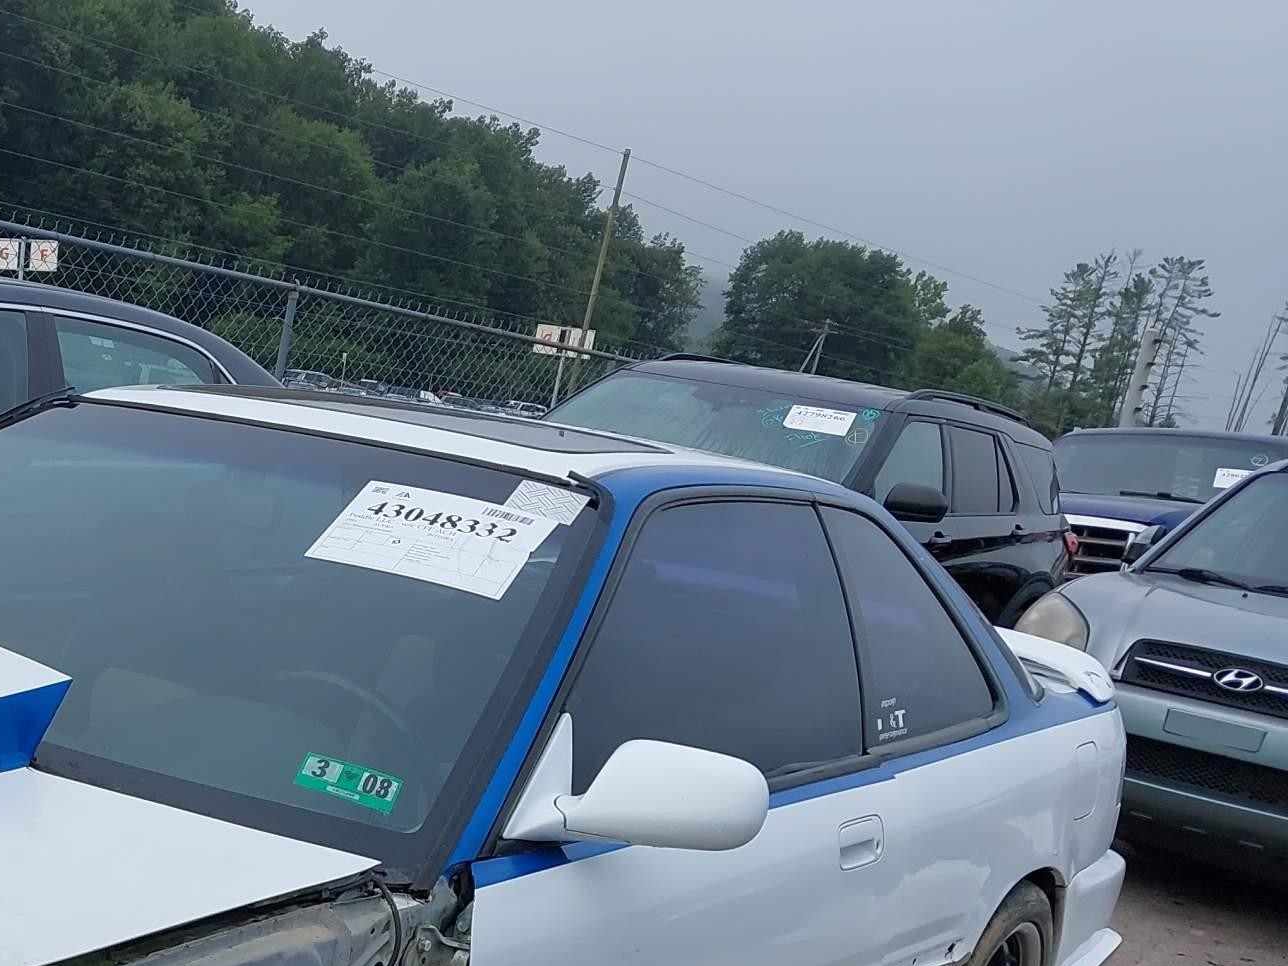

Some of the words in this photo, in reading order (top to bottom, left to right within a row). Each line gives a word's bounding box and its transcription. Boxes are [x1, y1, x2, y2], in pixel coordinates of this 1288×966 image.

[0, 248, 9, 260] G
[40, 249, 49, 261] F
[367, 501, 517, 543] 43048332
[312, 759, 329, 777] 3
[362, 774, 392, 798] 08
